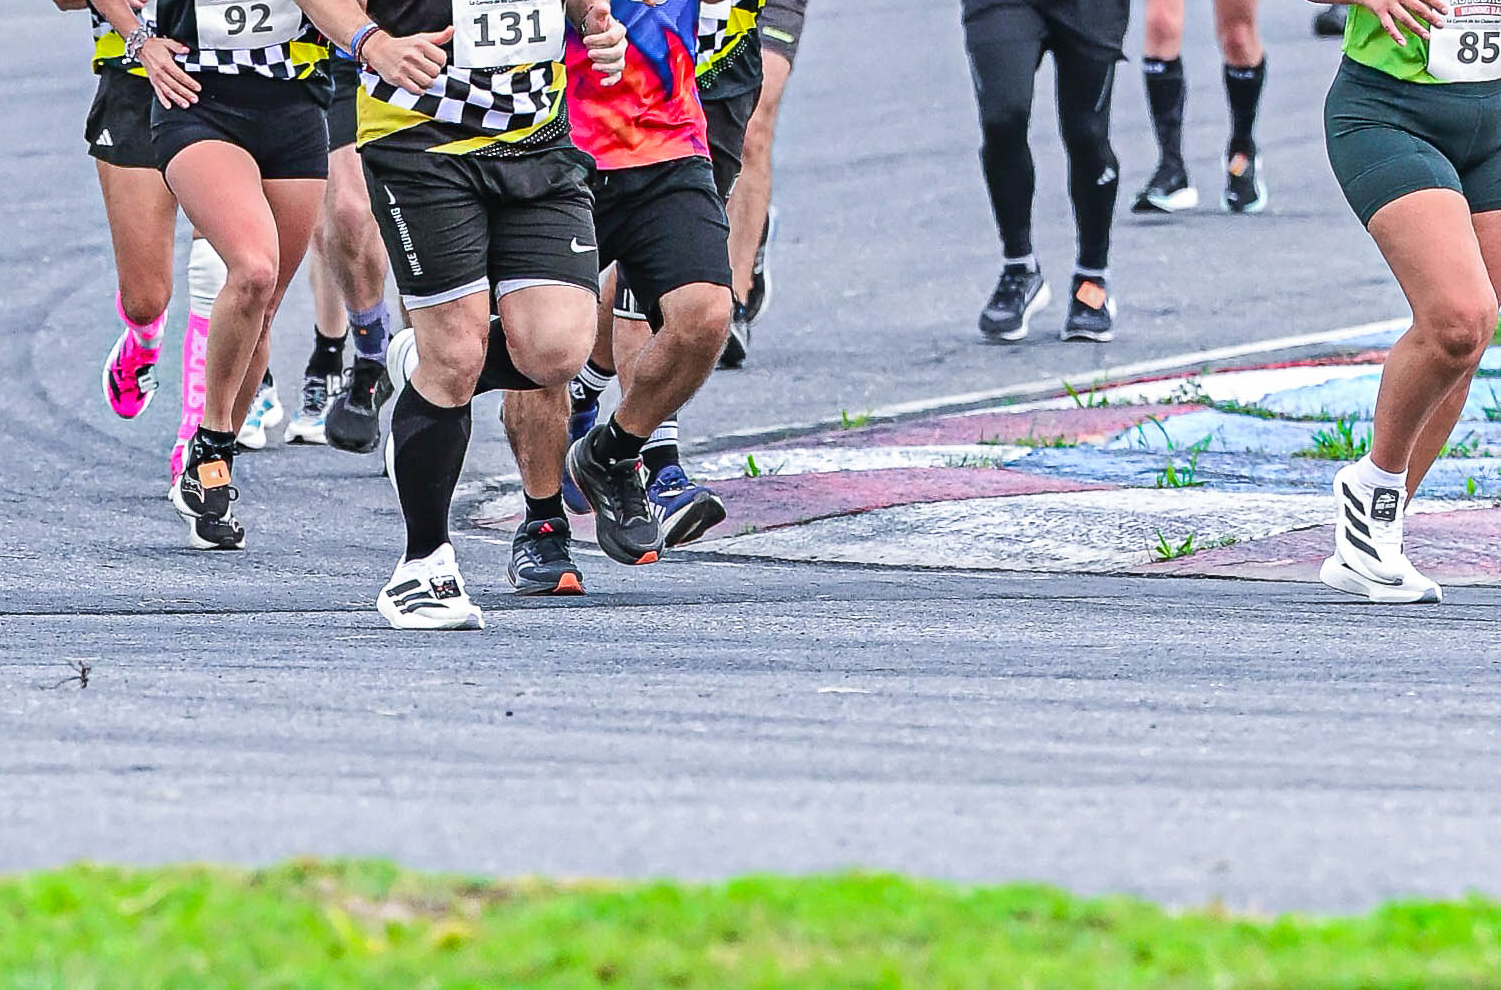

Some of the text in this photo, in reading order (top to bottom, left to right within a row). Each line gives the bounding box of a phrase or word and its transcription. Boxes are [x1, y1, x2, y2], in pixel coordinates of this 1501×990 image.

[224, 3, 273, 36] 92
[473, 9, 547, 48] 131
[1457, 30, 1501, 65] 85
[390, 207, 424, 276] NIKE RUNNING
